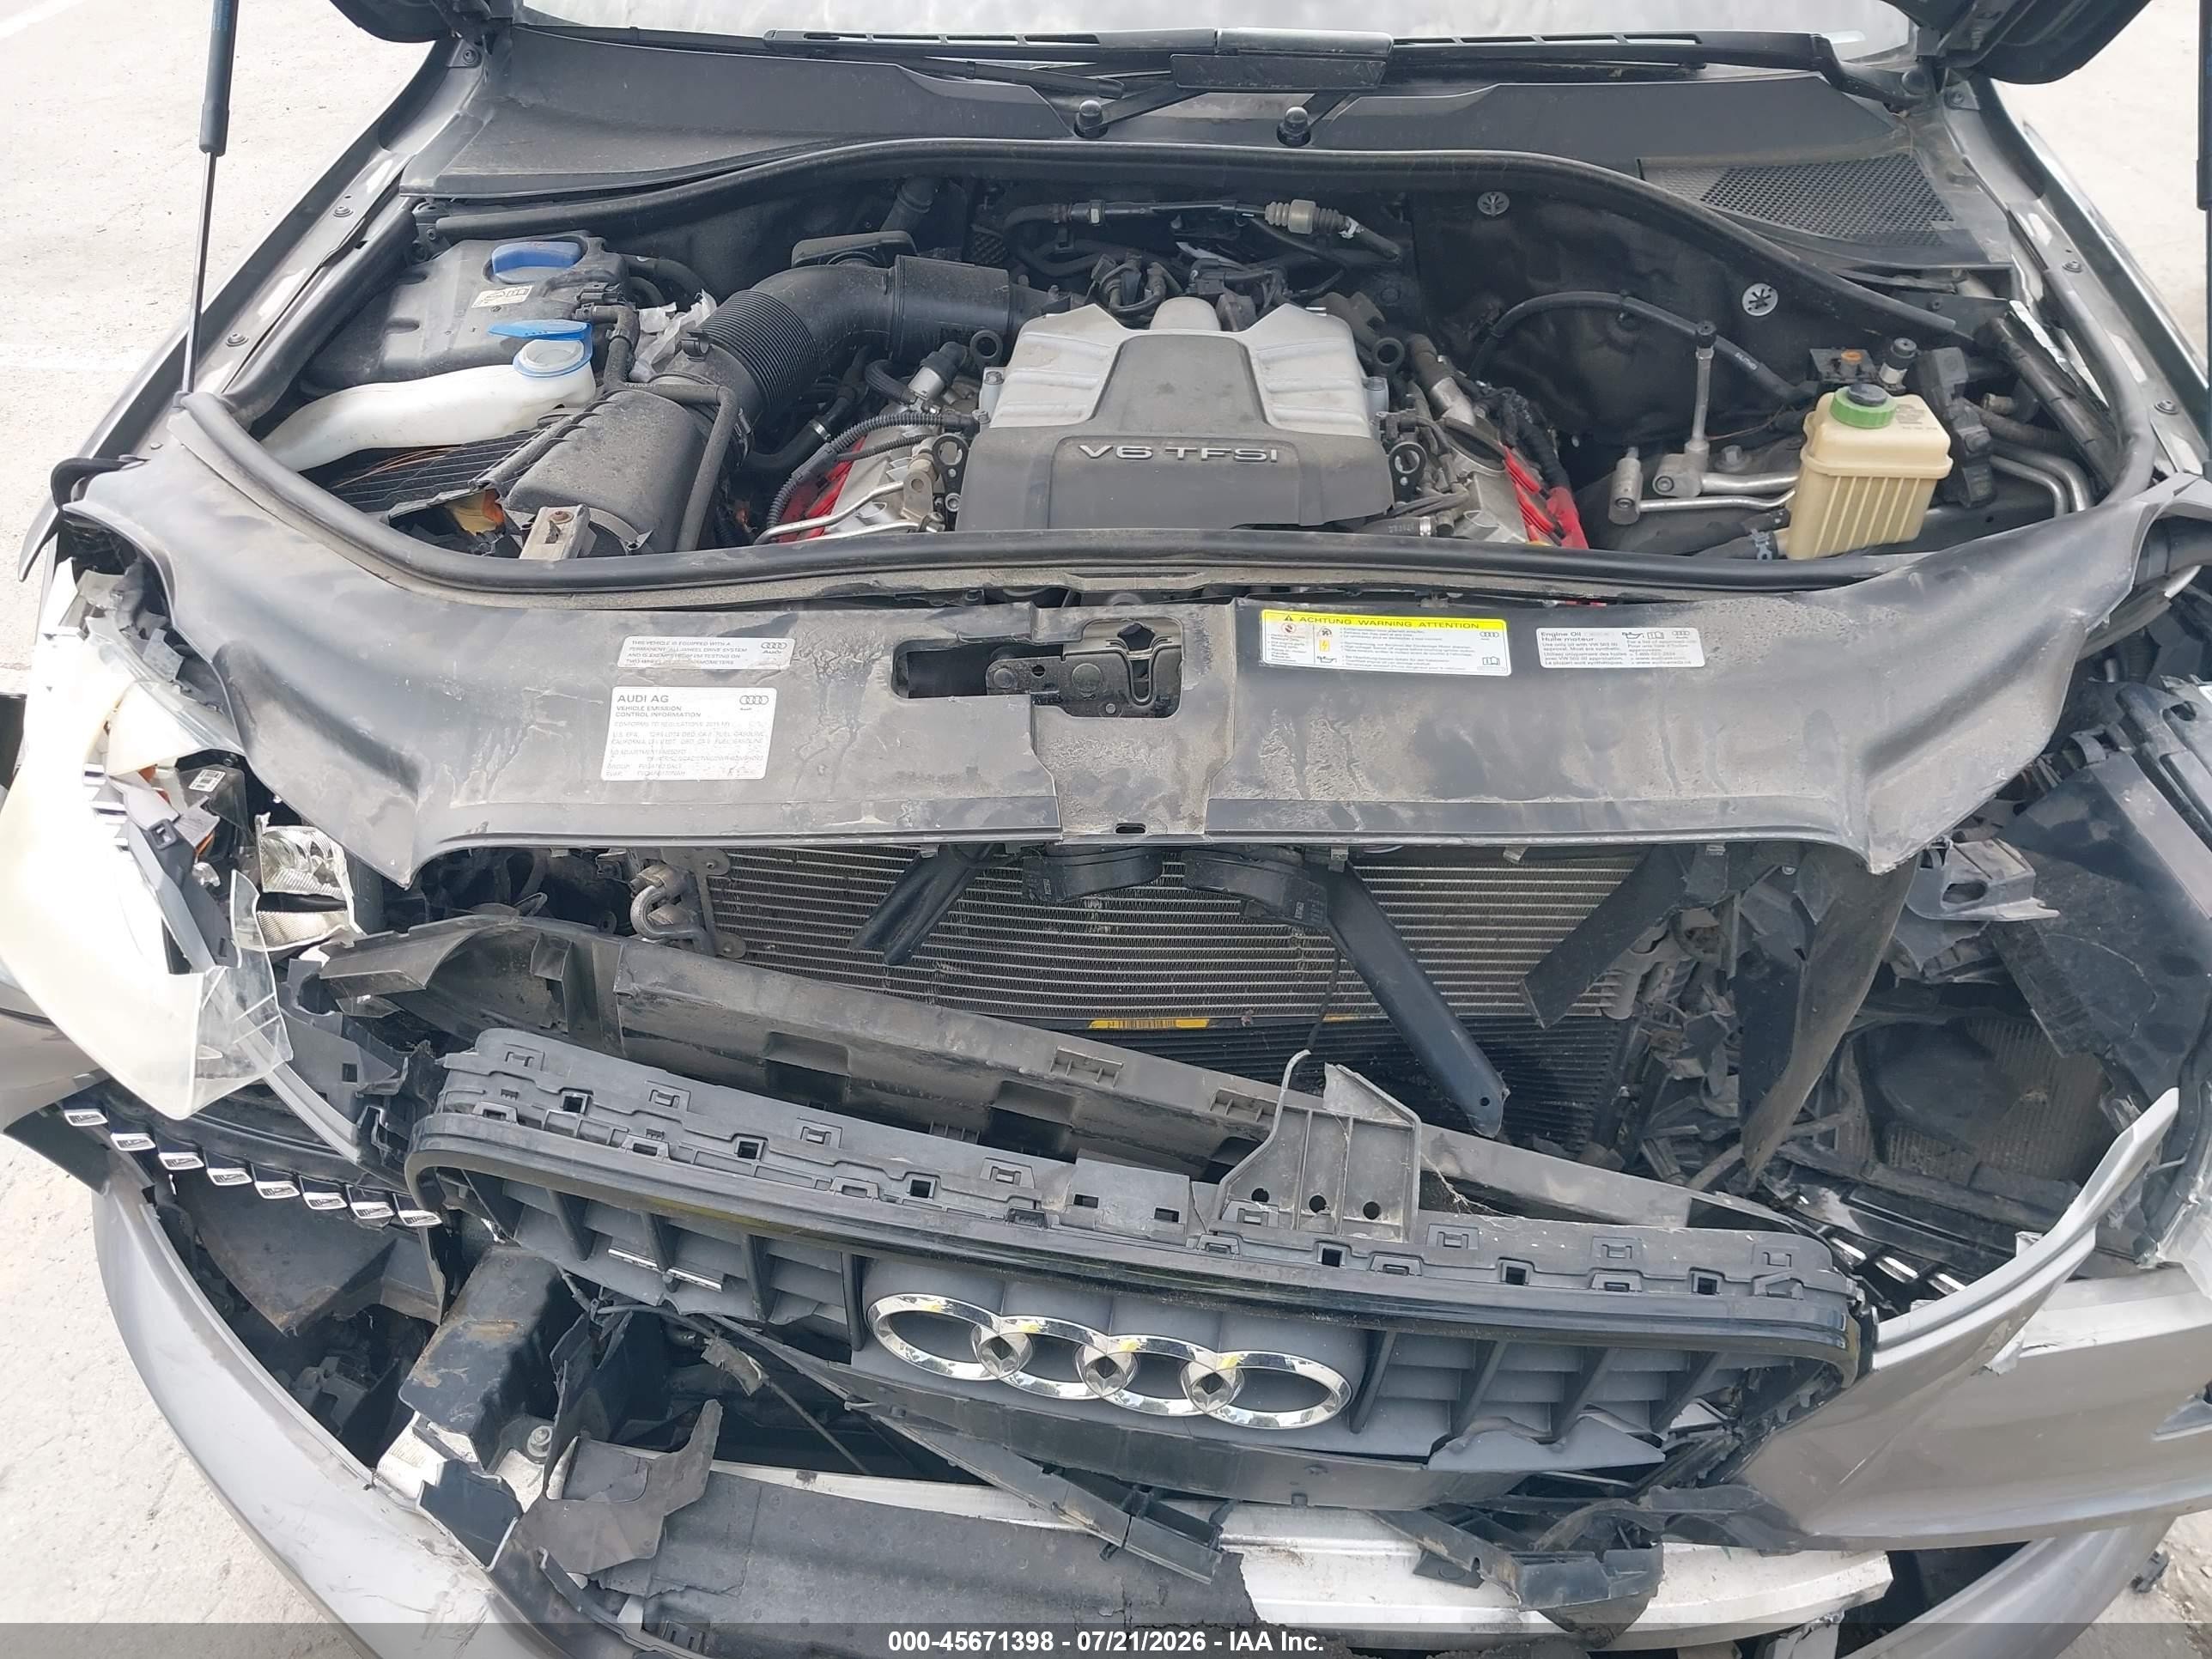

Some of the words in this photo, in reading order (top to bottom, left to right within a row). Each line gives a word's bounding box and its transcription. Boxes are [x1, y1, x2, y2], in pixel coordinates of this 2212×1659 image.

[1079, 445, 1152, 459] V6
[1164, 447, 1278, 462] TFSI
[1299, 617, 1352, 625] ACHTUNG
